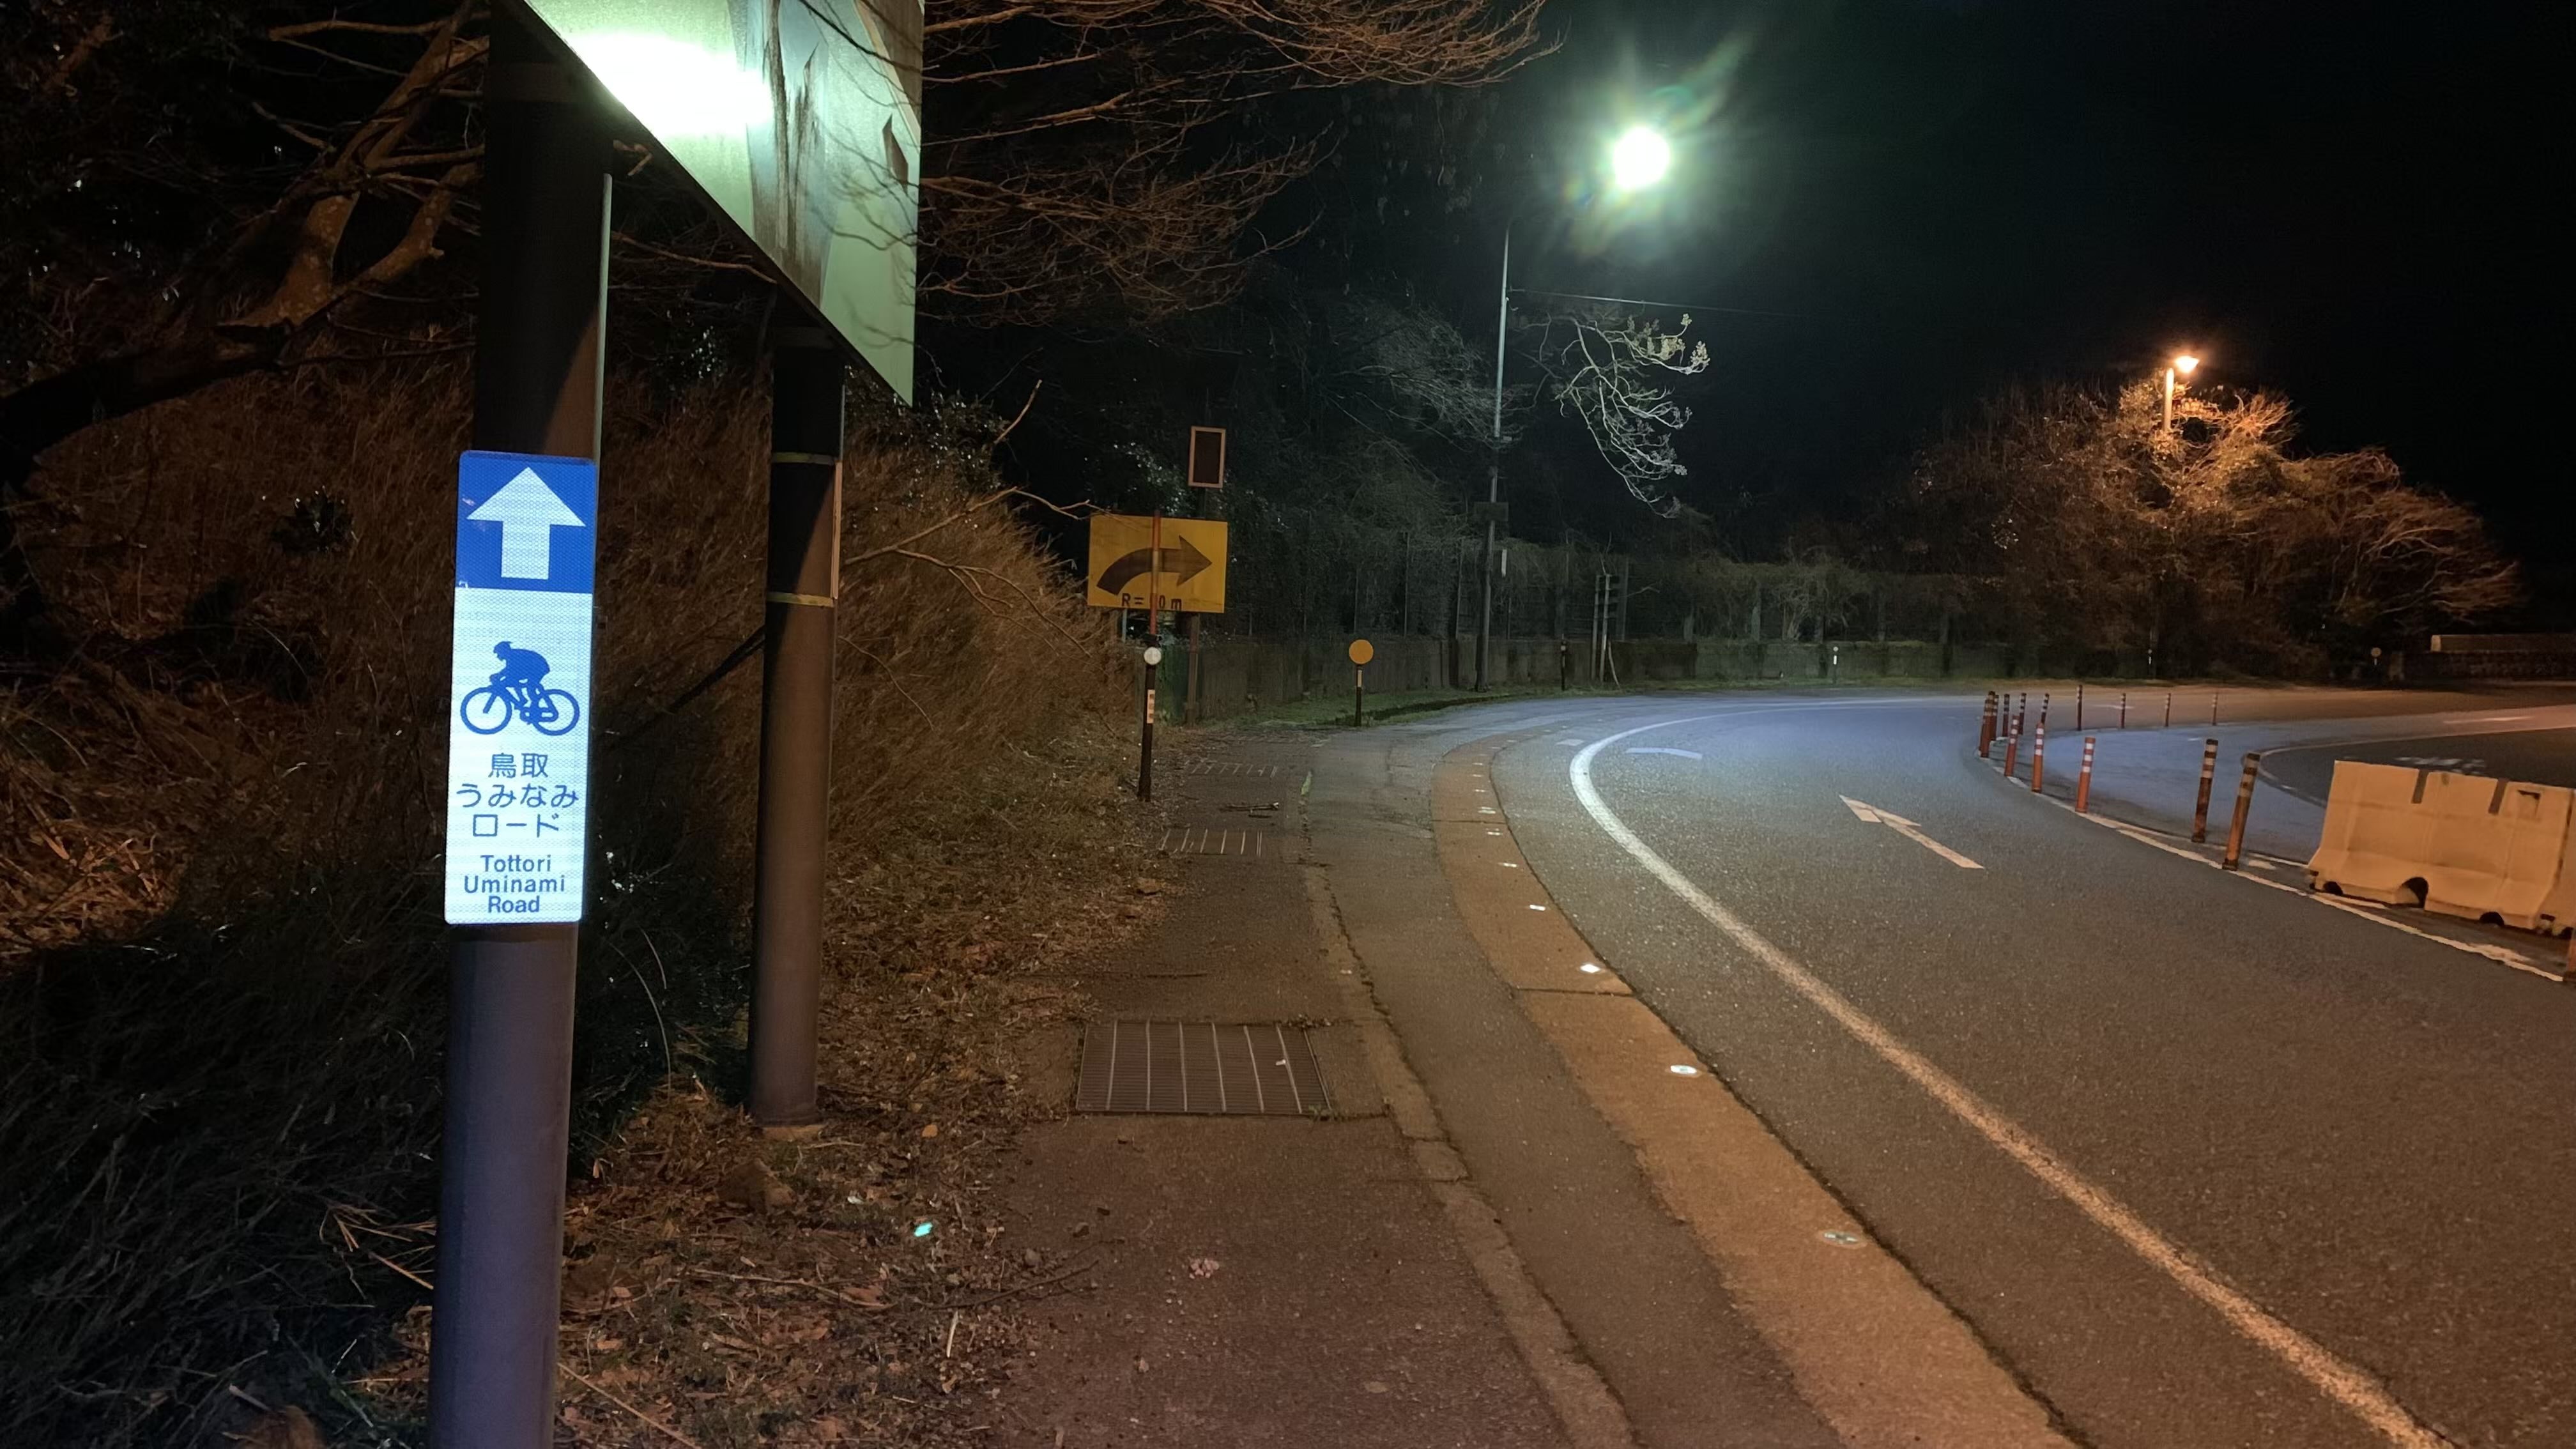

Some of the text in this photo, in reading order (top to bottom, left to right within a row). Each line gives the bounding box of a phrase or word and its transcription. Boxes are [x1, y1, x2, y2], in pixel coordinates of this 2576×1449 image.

[1122, 592, 1182, 610] R=0m
[488, 753, 548, 778] 鳥取
[456, 783, 579, 808] うみなみ
[473, 813, 559, 838] ロード
[480, 855, 551, 872] Tottori
[464, 875, 565, 894] Uminami
[488, 896, 540, 913] Road
